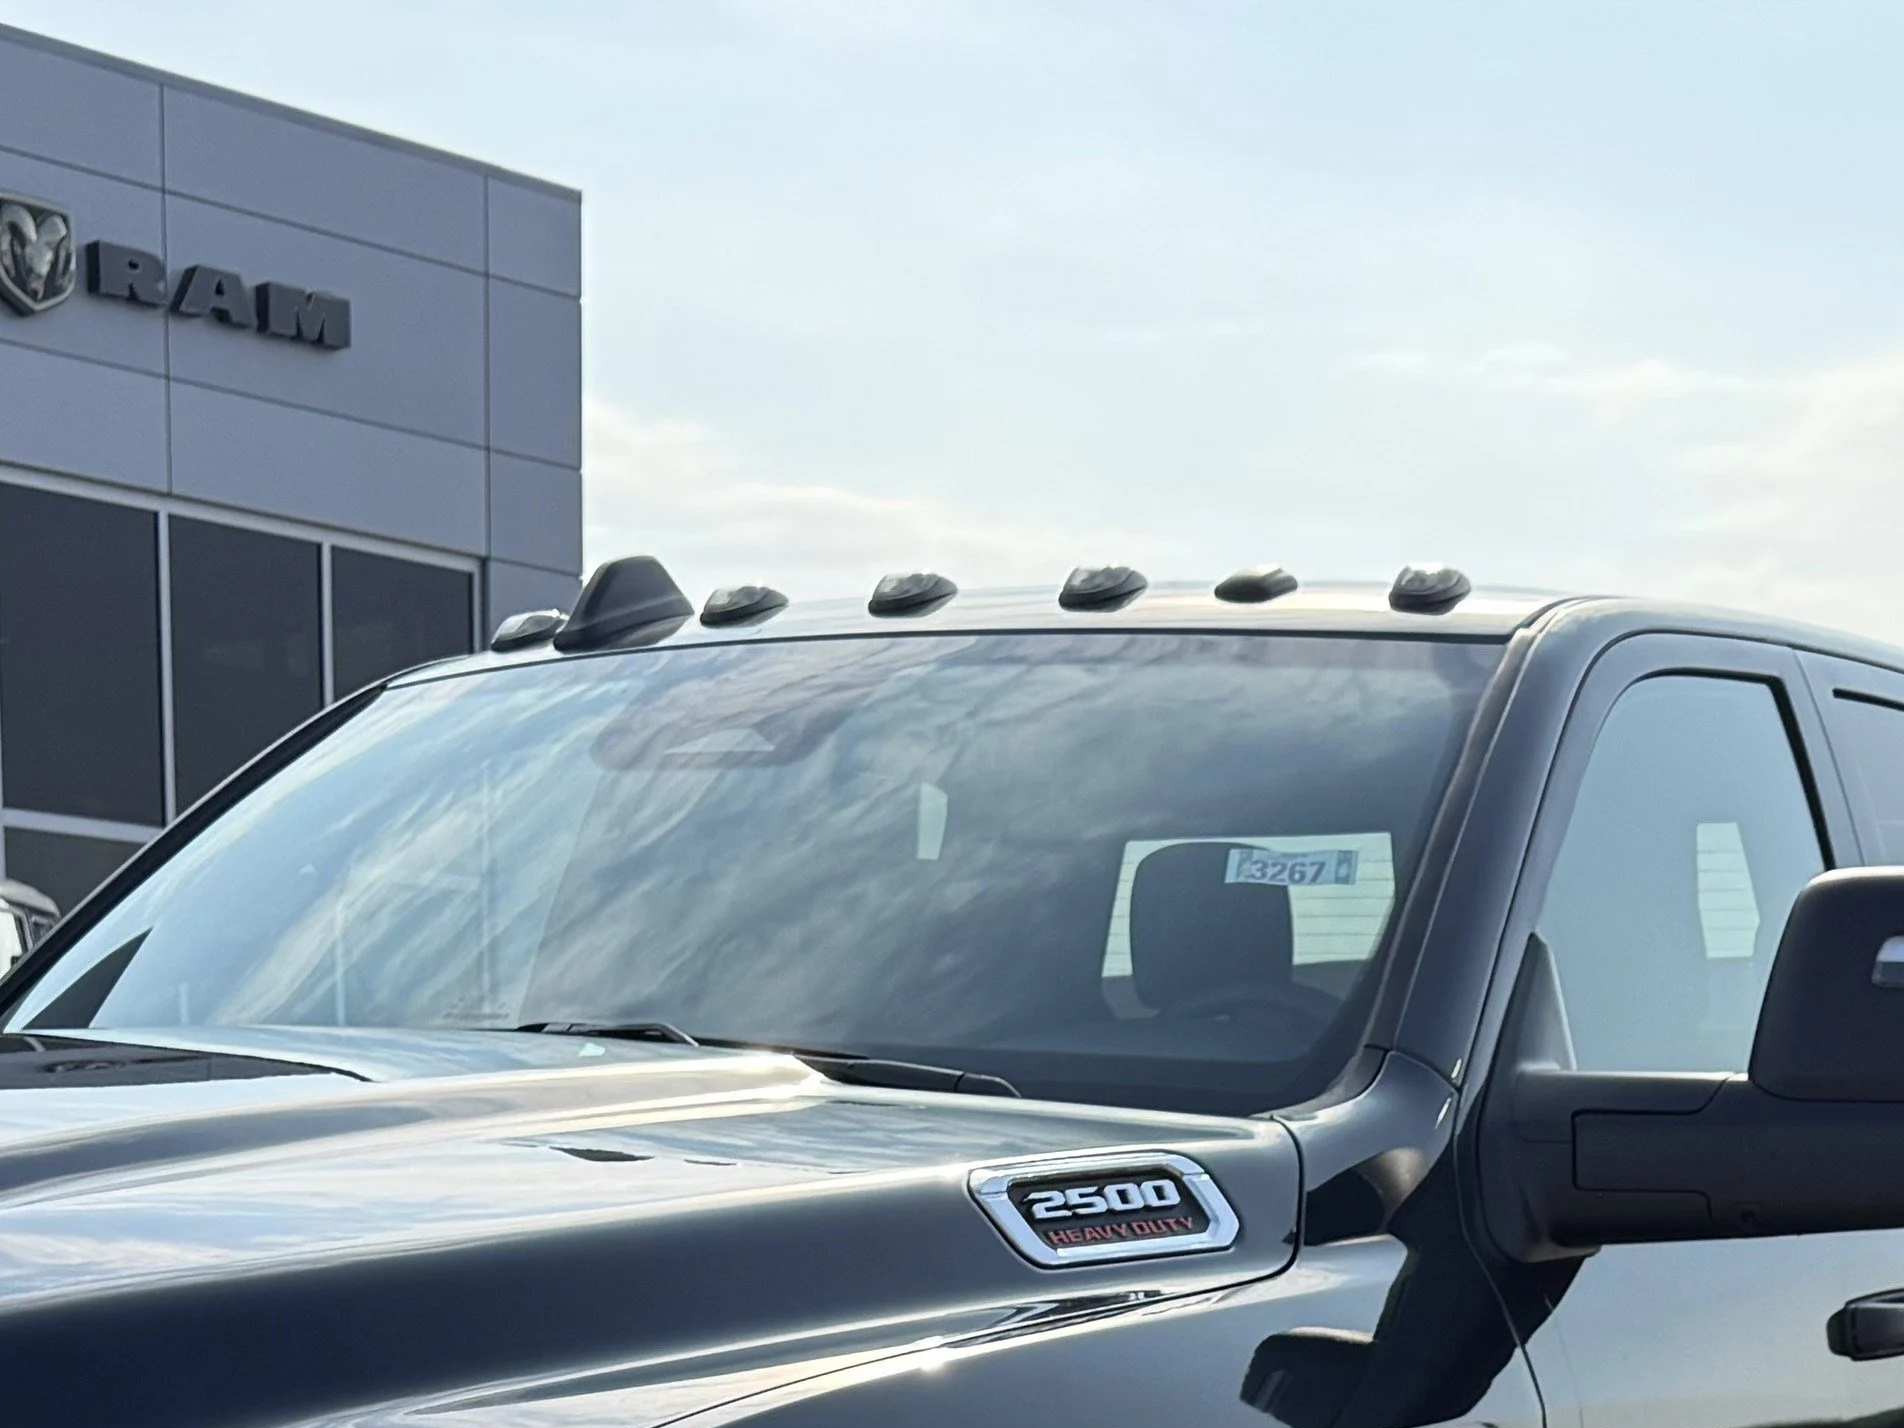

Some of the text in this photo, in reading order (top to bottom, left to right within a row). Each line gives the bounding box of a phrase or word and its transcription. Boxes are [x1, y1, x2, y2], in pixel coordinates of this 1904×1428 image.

[86, 240, 351, 350] RAM
[1025, 1179, 1181, 1219] 2500
[1048, 1216, 1194, 1245] HEAVY DUTY
